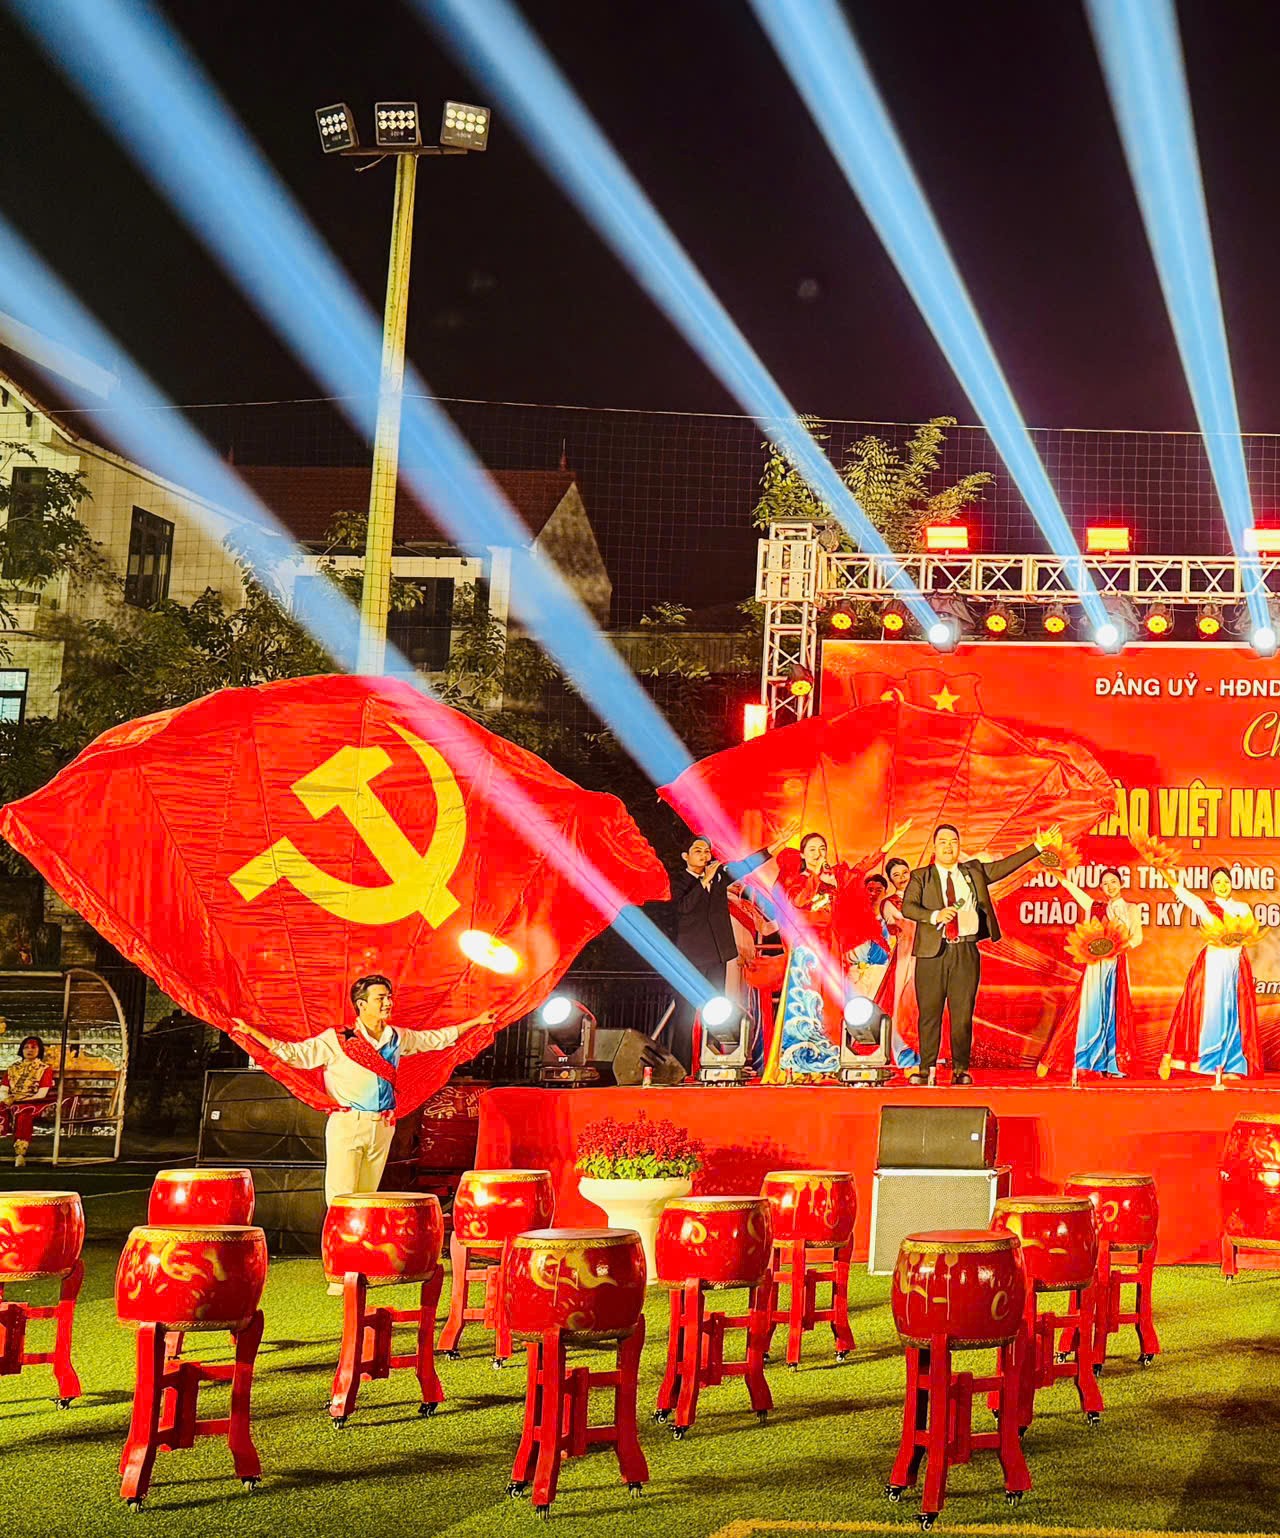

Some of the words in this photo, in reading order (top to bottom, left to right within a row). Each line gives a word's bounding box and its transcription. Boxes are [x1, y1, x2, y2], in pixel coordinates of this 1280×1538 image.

[1095, 671, 1161, 697] ĐẢNG
[1168, 671, 1199, 697] UỶ
[1089, 778, 1150, 836] ÀO
[1159, 778, 1223, 849] VIỆT
[1067, 861, 1131, 889] MỪG
[1231, 862, 1274, 890] ÔNG
[1019, 896, 1078, 925] CHÀO
[1255, 904, 1280, 927] 96
